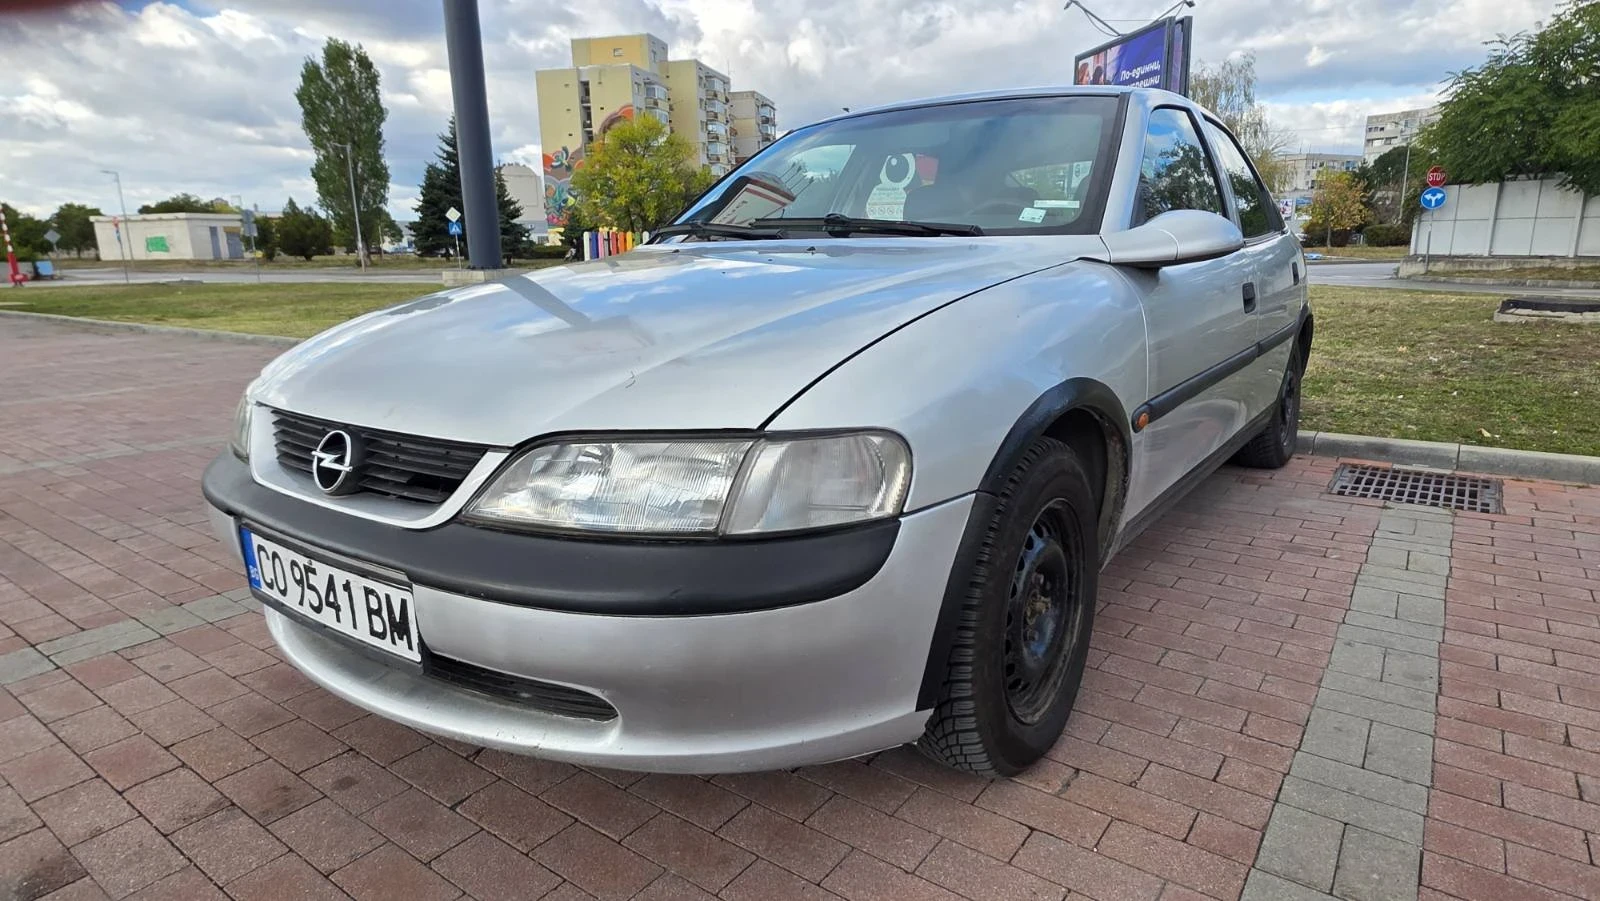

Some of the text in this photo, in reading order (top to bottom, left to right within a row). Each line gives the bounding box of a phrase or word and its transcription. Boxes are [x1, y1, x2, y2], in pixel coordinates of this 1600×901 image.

[1120, 60, 1160, 81] По-единни,
[1429, 173, 1445, 181] STOP
[257, 544, 413, 651] CO 9541 BM
